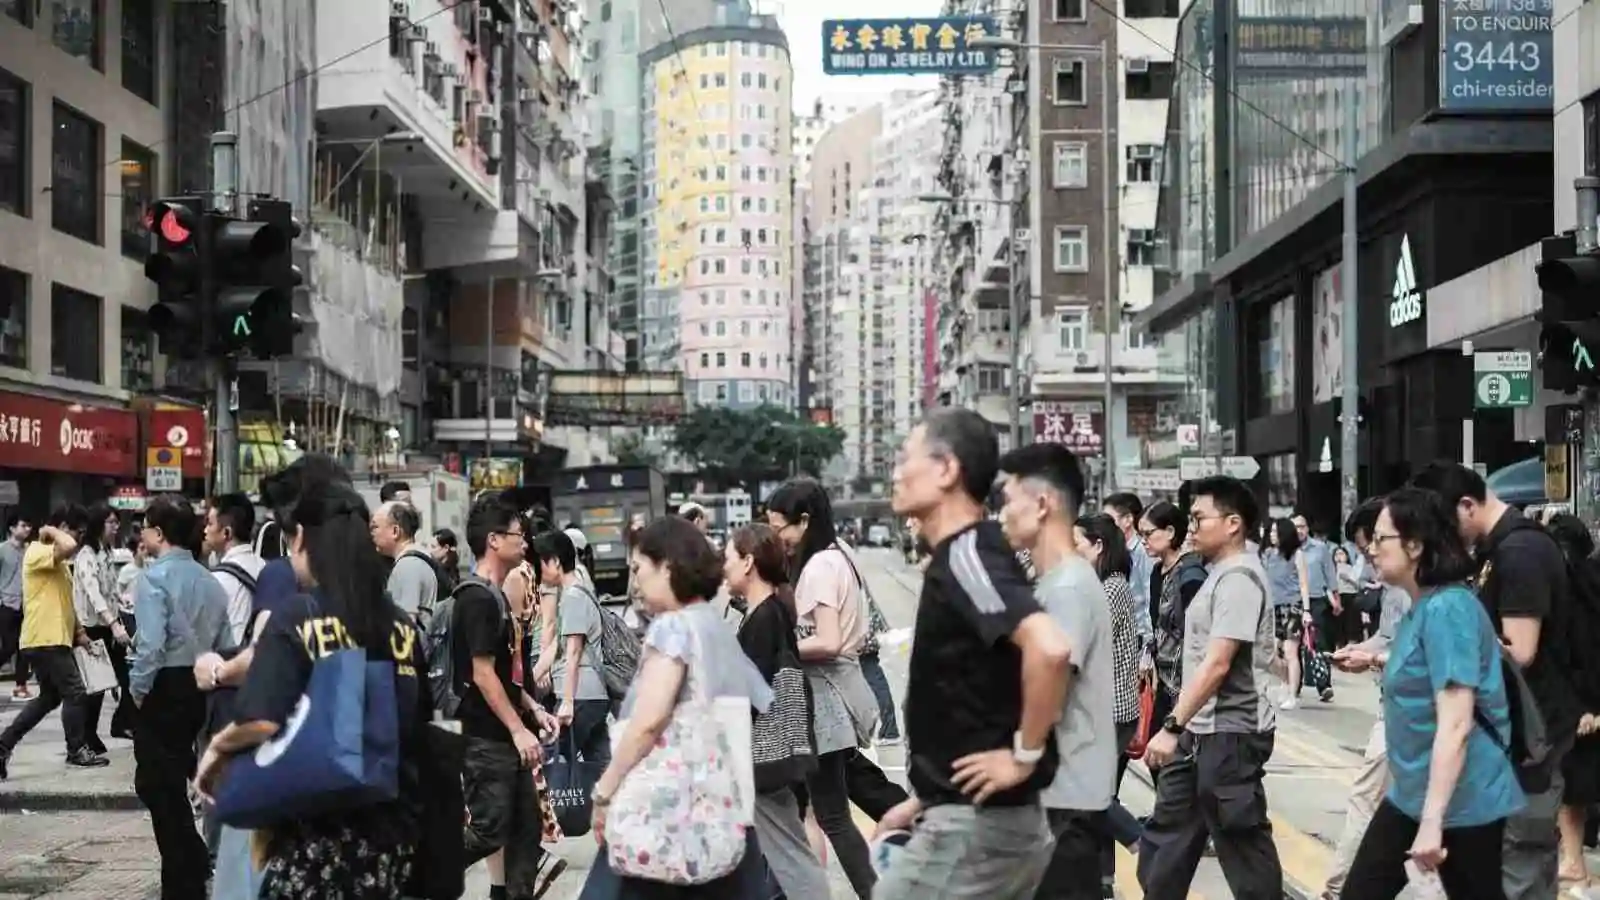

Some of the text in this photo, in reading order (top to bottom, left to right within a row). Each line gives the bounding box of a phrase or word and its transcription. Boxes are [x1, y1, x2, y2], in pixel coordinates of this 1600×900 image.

[1452, 16, 1553, 31] TO ENQUIR
[831, 53, 865, 67] WING
[868, 53, 888, 67] ON
[891, 52, 954, 67] JEWELRY
[1453, 41, 1540, 71] 3443
[1390, 291, 1421, 327] adidas
[549, 788, 584, 798] PEARLY
[549, 797, 585, 807] GATES
